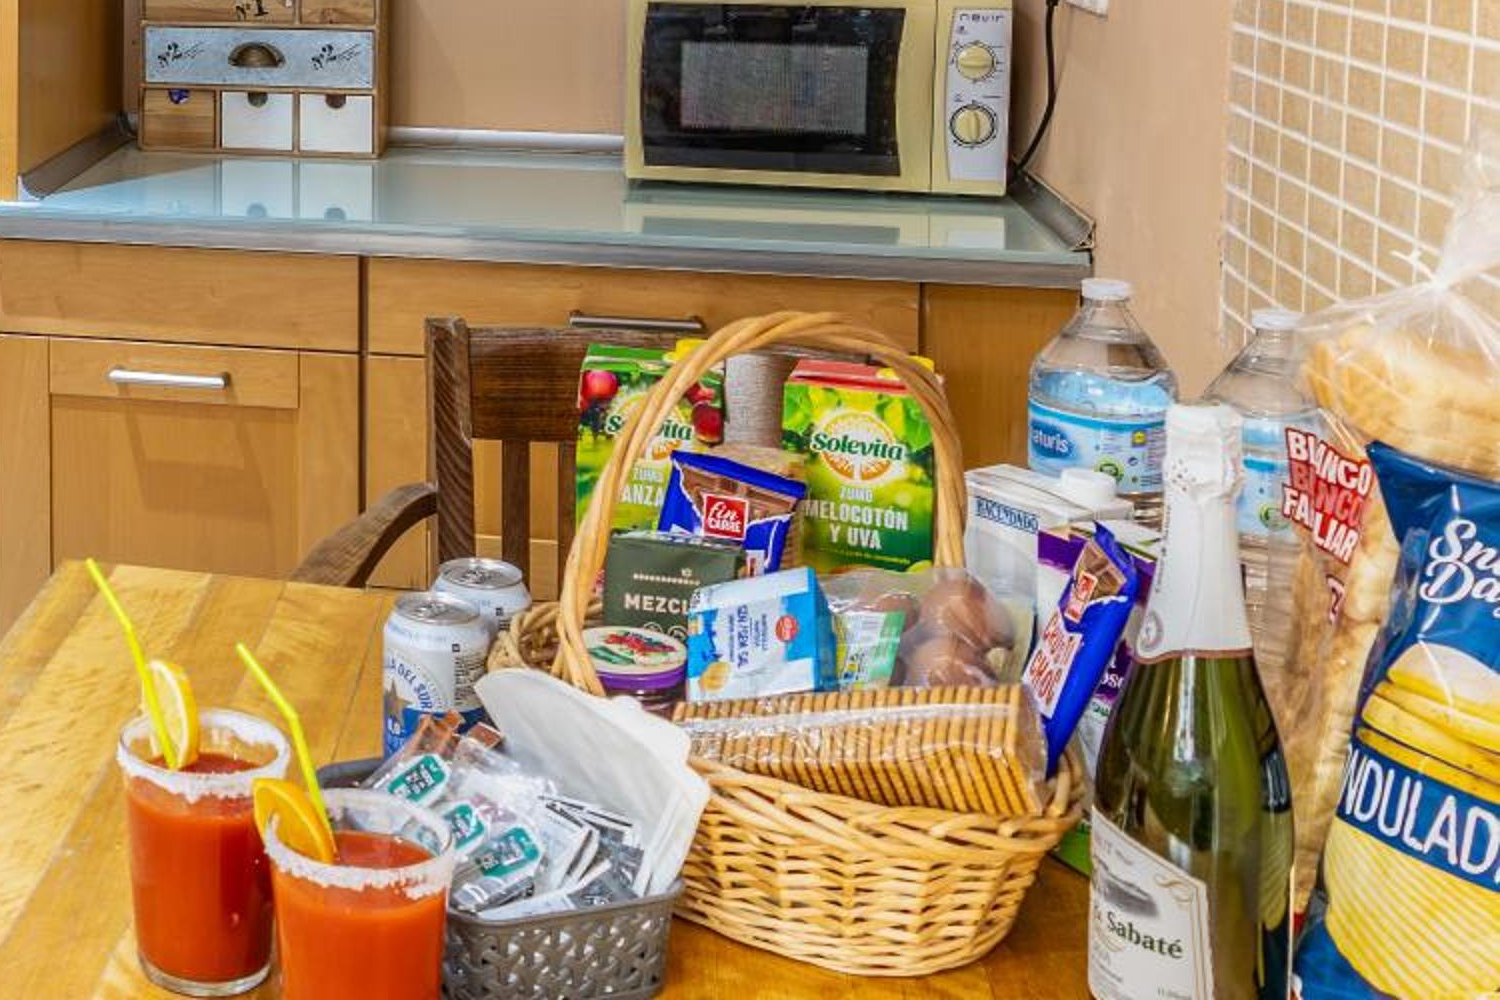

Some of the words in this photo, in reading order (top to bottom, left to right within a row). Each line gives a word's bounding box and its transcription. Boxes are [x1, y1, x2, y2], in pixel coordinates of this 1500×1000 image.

[812, 433, 903, 460] Solevita
[804, 497, 908, 531] MELOCOTÓN
[830, 522, 841, 543] Y
[848, 526, 882, 550] UVA
[414, 684, 432, 709] SUR
[1338, 744, 1500, 885] NDULAD
[1107, 911, 1184, 959] Sabaté
